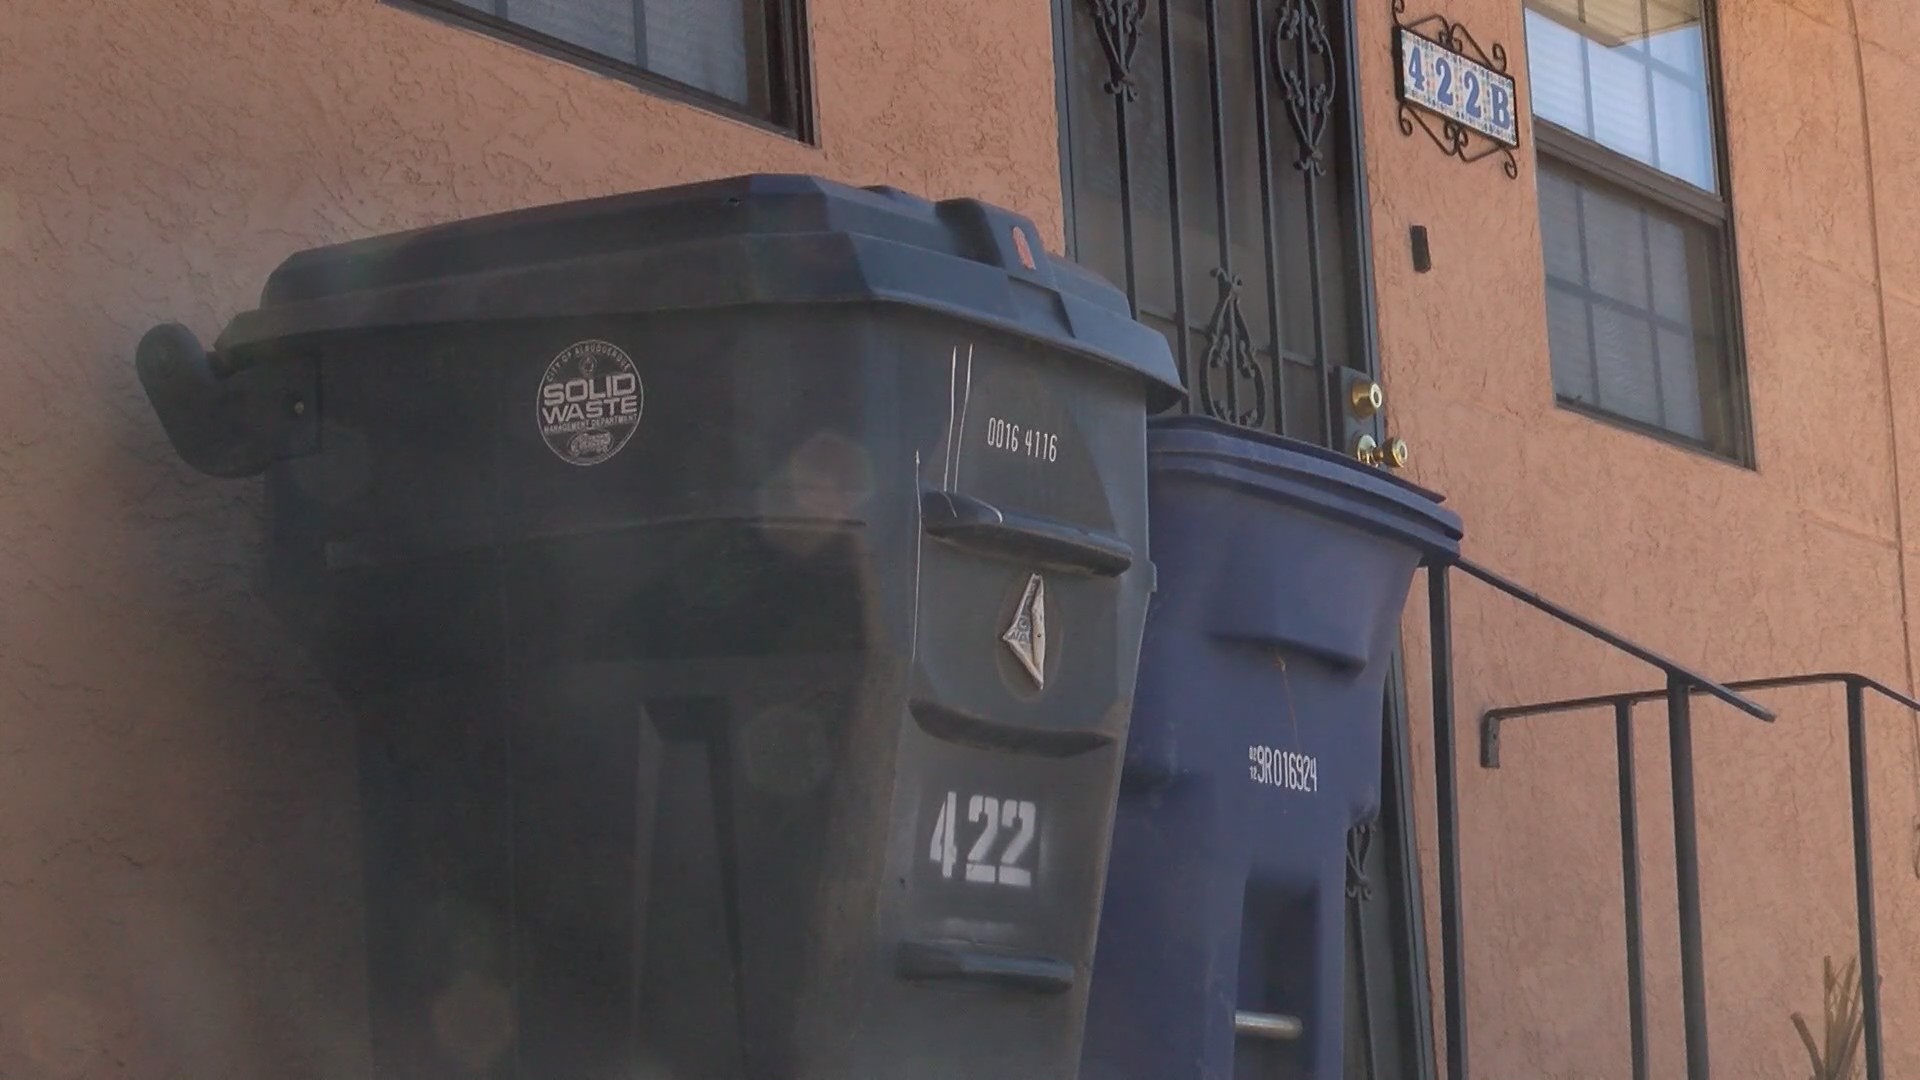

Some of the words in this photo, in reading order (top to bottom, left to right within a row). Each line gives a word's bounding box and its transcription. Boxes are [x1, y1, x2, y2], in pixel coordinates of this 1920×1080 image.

[1409, 46, 1510, 130] 422B
[543, 373, 636, 406] SOLID
[542, 395, 638, 424] WASTE
[543, 419, 589, 433] MANAGEMENT
[591, 413, 638, 427] DEPARTMENT
[987, 417, 1020, 453] 0016
[1025, 429, 1058, 462] 4116
[929, 791, 1037, 888] 422
